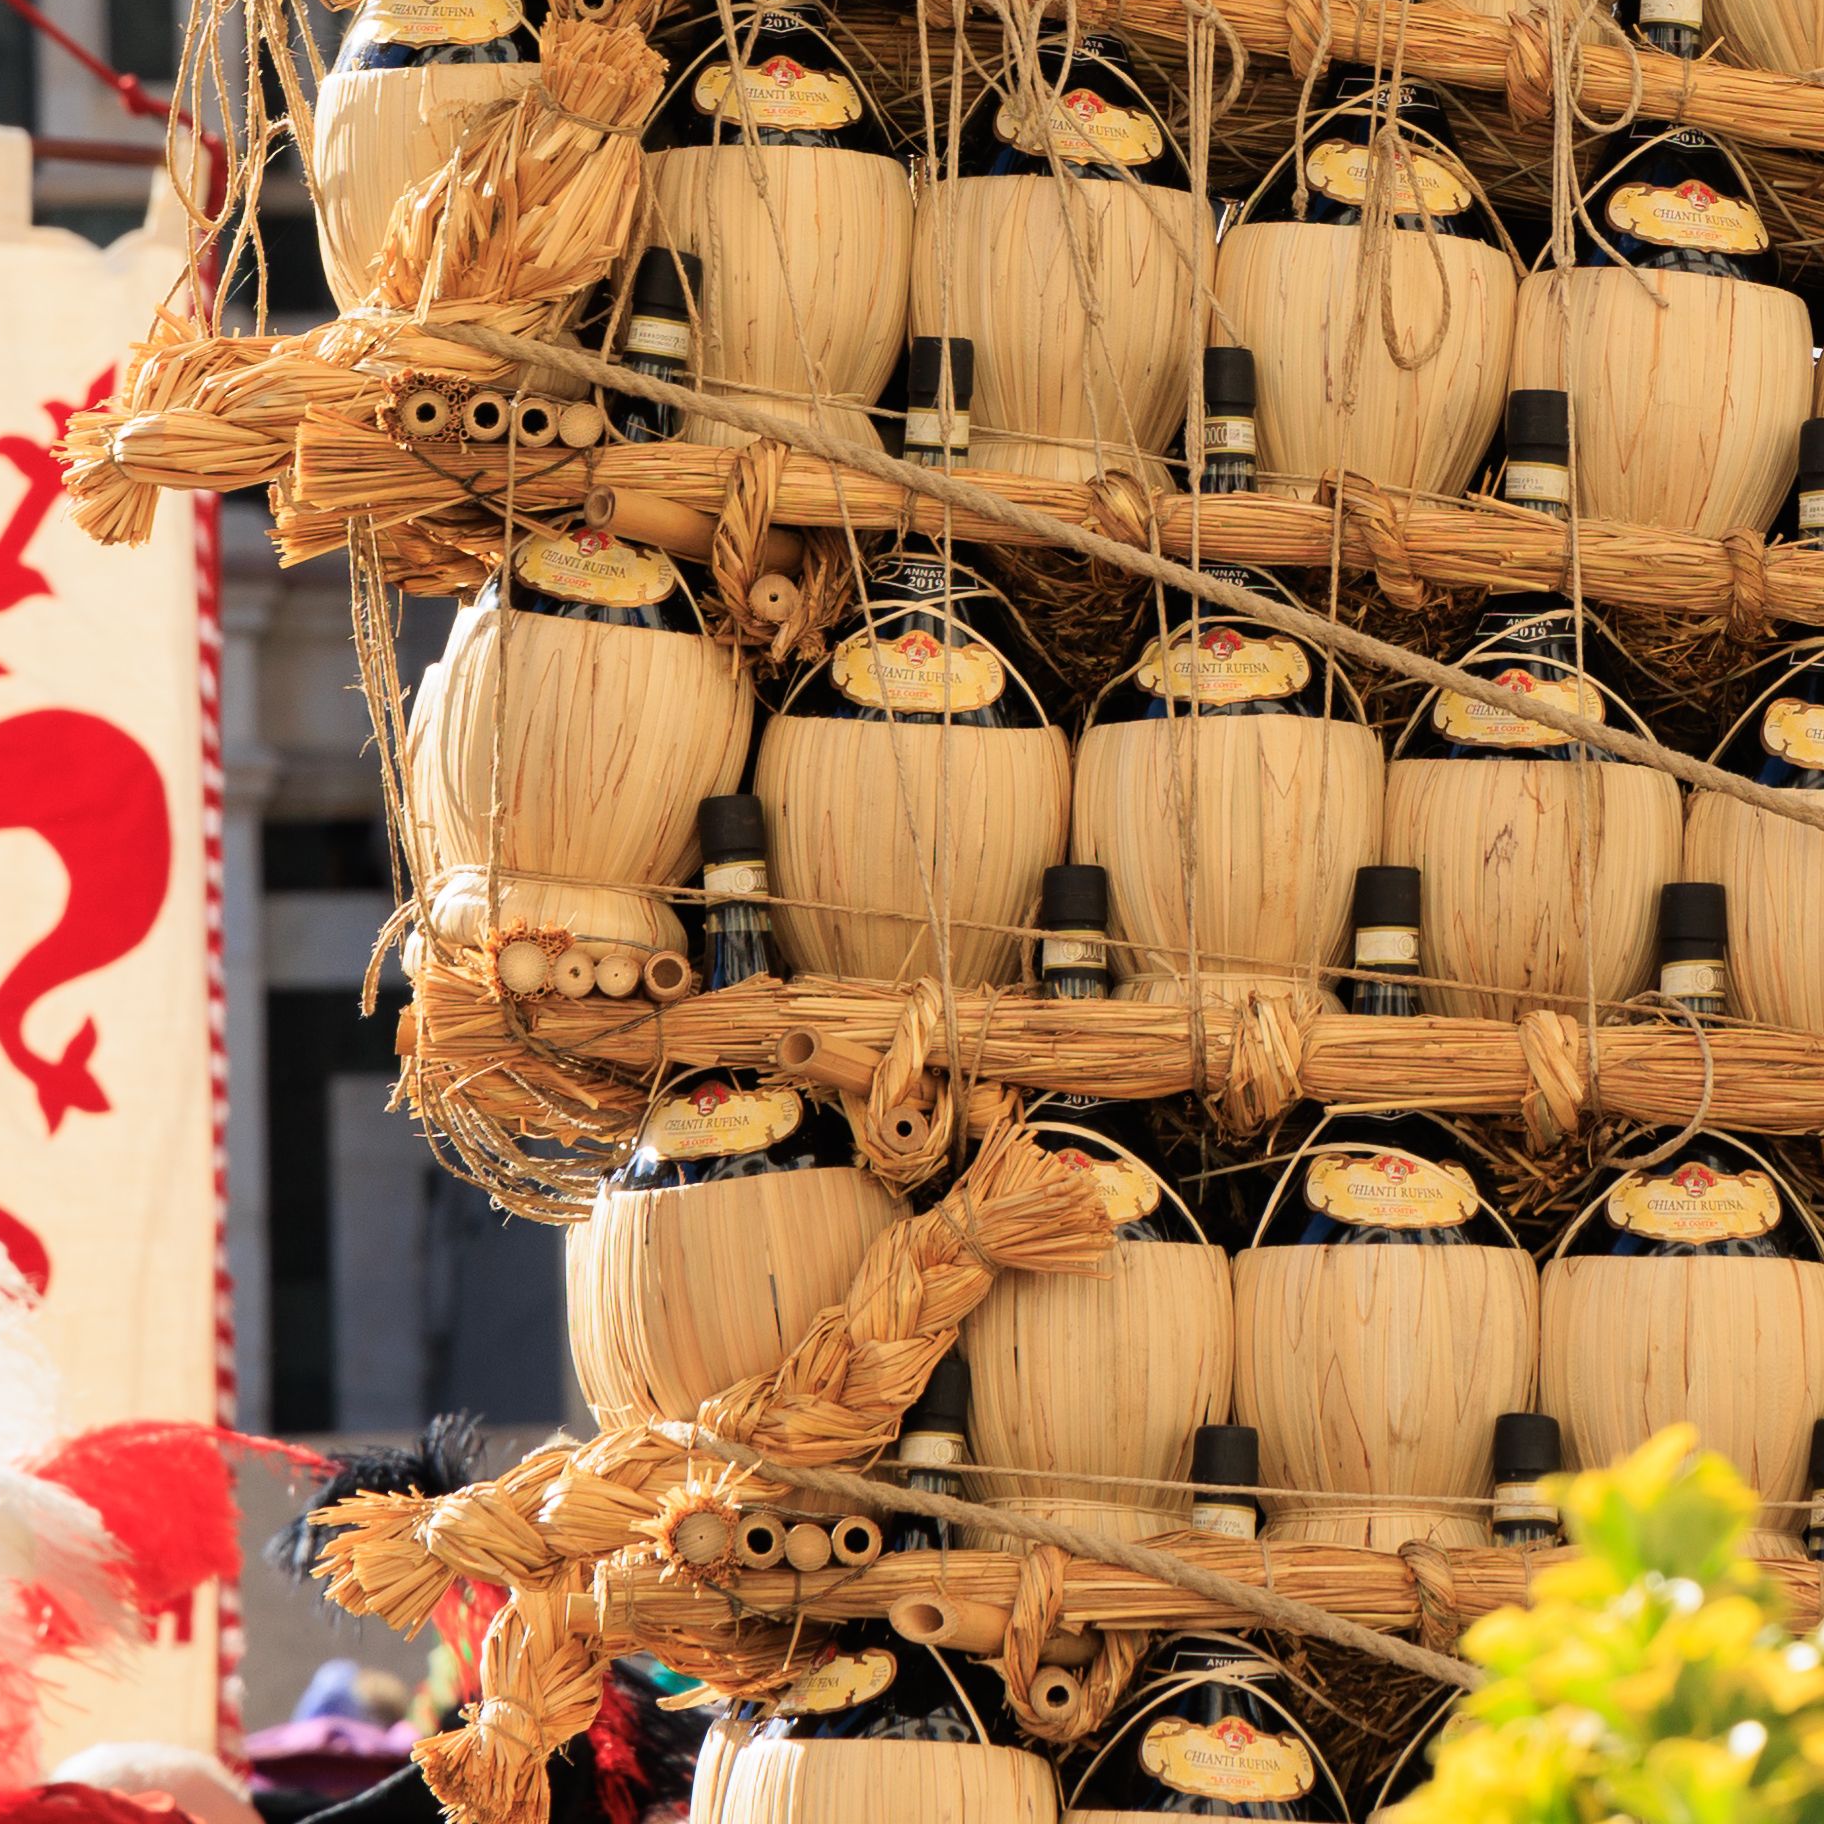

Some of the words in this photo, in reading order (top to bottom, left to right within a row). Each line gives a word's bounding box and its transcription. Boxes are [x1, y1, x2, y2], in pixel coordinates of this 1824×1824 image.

[431, 6, 476, 18] RUFINA
[746, 86, 786, 100] HIANTI
[789, 91, 831, 103] RUFINA
[1089, 124, 1129, 140] RUFINA
[1653, 207, 1703, 223] CHIANTI
[1705, 214, 1741, 229] RUFINA
[540, 549, 581, 568] CHIANTI
[582, 560, 626, 578] RUFINA
[906, 576, 945, 589] 2019
[1226, 663, 1270, 674] RUFINA
[664, 1117, 705, 1130] CHIANTI
[705, 1115, 748, 1129] RUFINA
[1347, 1183, 1397, 1197] CHIANTI
[1400, 1187, 1444, 1200] RUFINA
[1647, 1199, 1697, 1211] CHIANTI
[1700, 1200, 1744, 1211] RUFINA
[1184, 1749, 1235, 1767] CHIANTI
[1238, 1757, 1283, 1773] RUFINA
